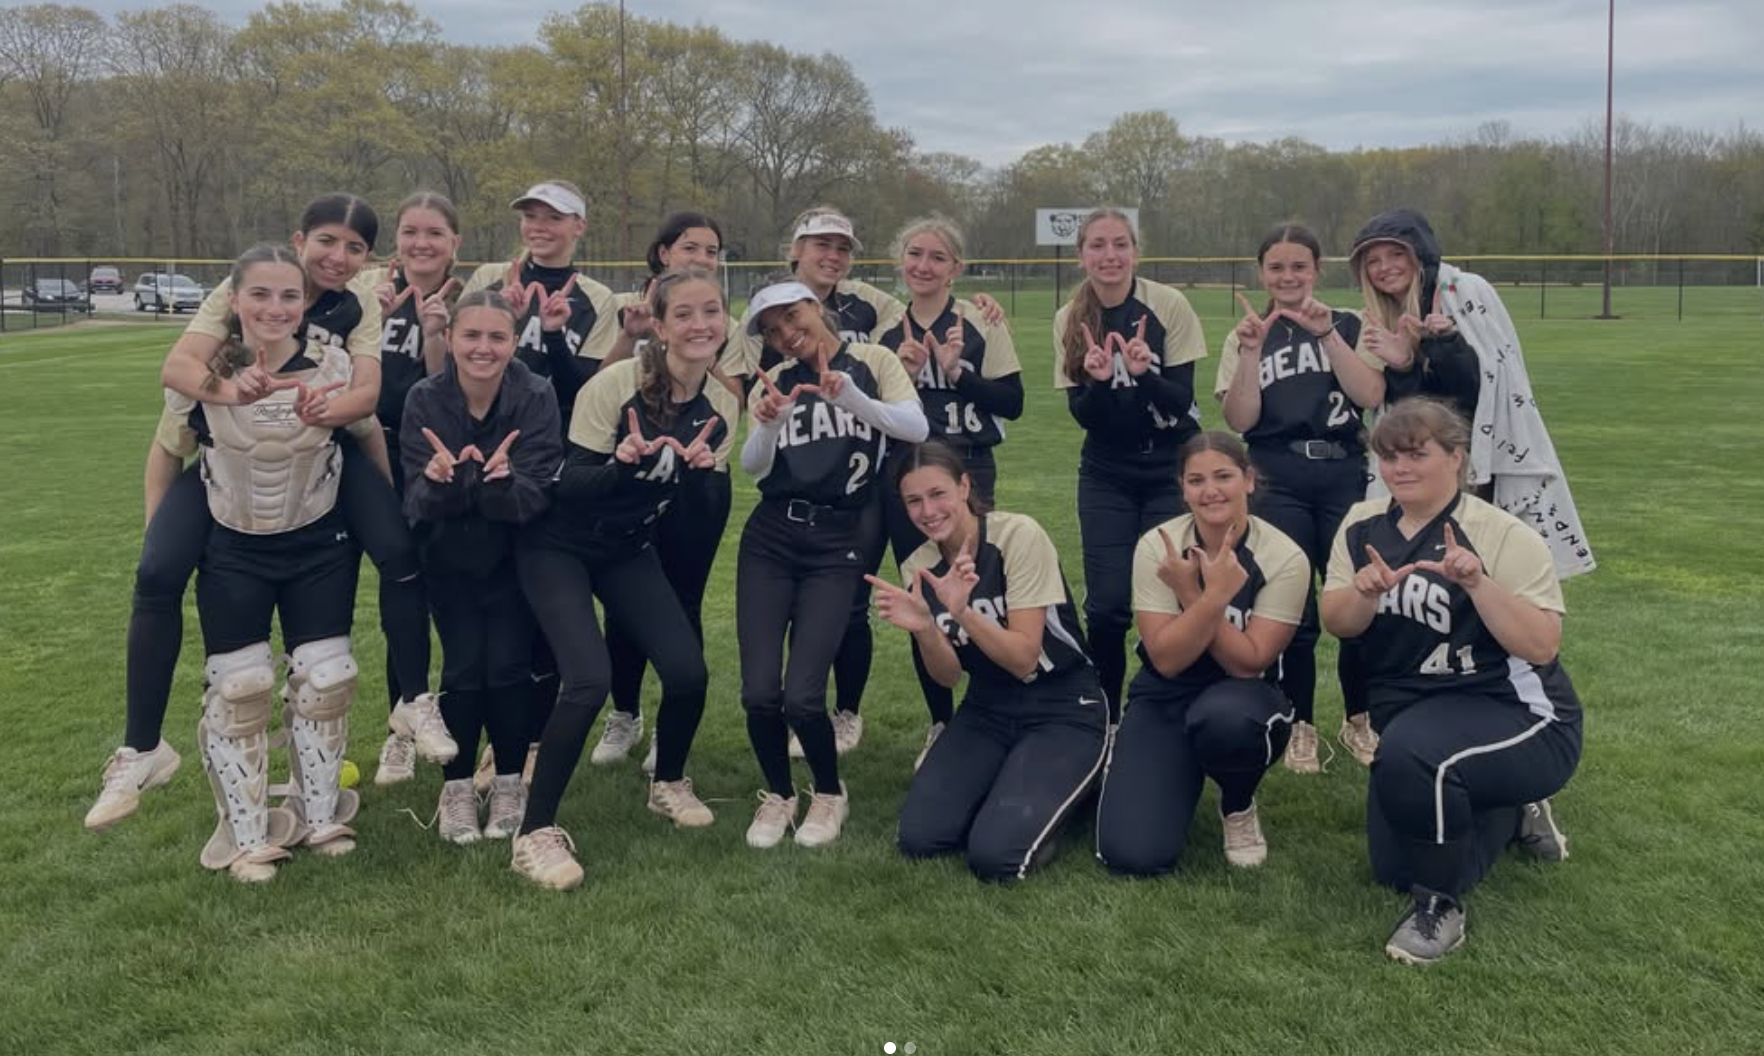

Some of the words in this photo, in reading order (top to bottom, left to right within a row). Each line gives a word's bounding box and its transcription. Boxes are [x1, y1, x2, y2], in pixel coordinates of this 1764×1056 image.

[944, 402, 982, 434] 16
[845, 452, 870, 495] 2
[1419, 642, 1478, 675] 41
